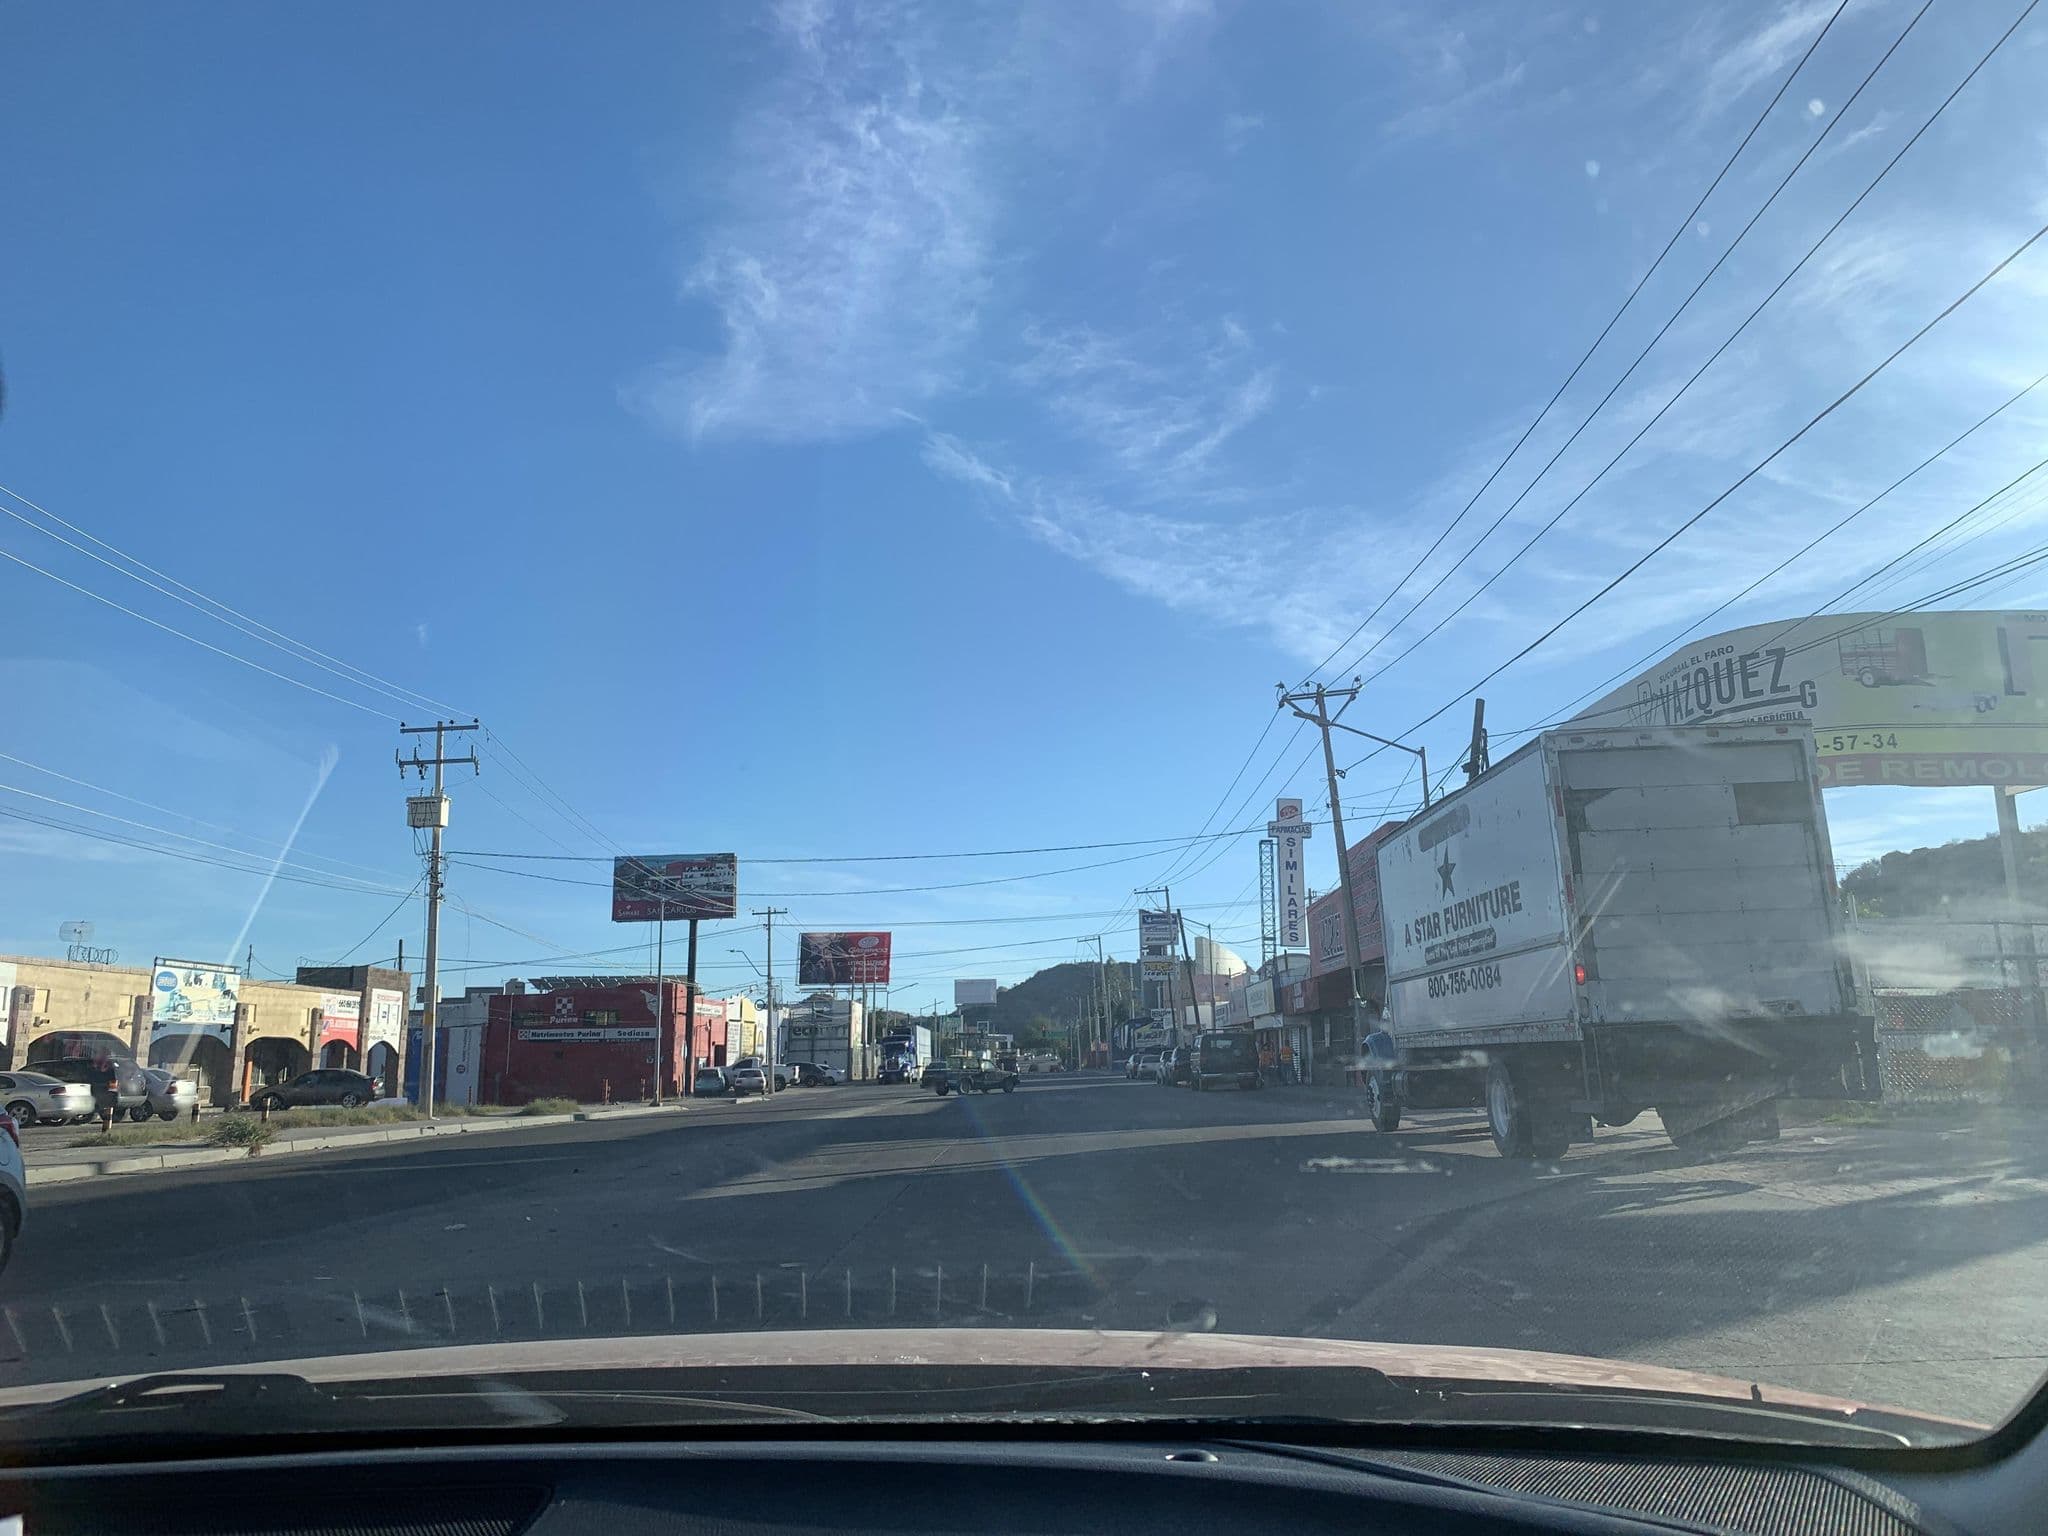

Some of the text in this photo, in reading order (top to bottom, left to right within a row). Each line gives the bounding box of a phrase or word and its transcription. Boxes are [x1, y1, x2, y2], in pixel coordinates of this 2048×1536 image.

[1659, 645, 1735, 684] SUCURSAL EL FARO
[1660, 647, 1818, 725] VAZQUEZ G
[1880, 758, 2048, 781] REMOL
[1271, 825, 1311, 834] FARMACIAS
[1285, 837, 1300, 942] SIMILARES
[1405, 923, 1412, 948] A
[1414, 912, 1442, 944] STAR
[1443, 880, 1522, 935] FURNITURE
[550, 1015, 579, 1024] Purina
